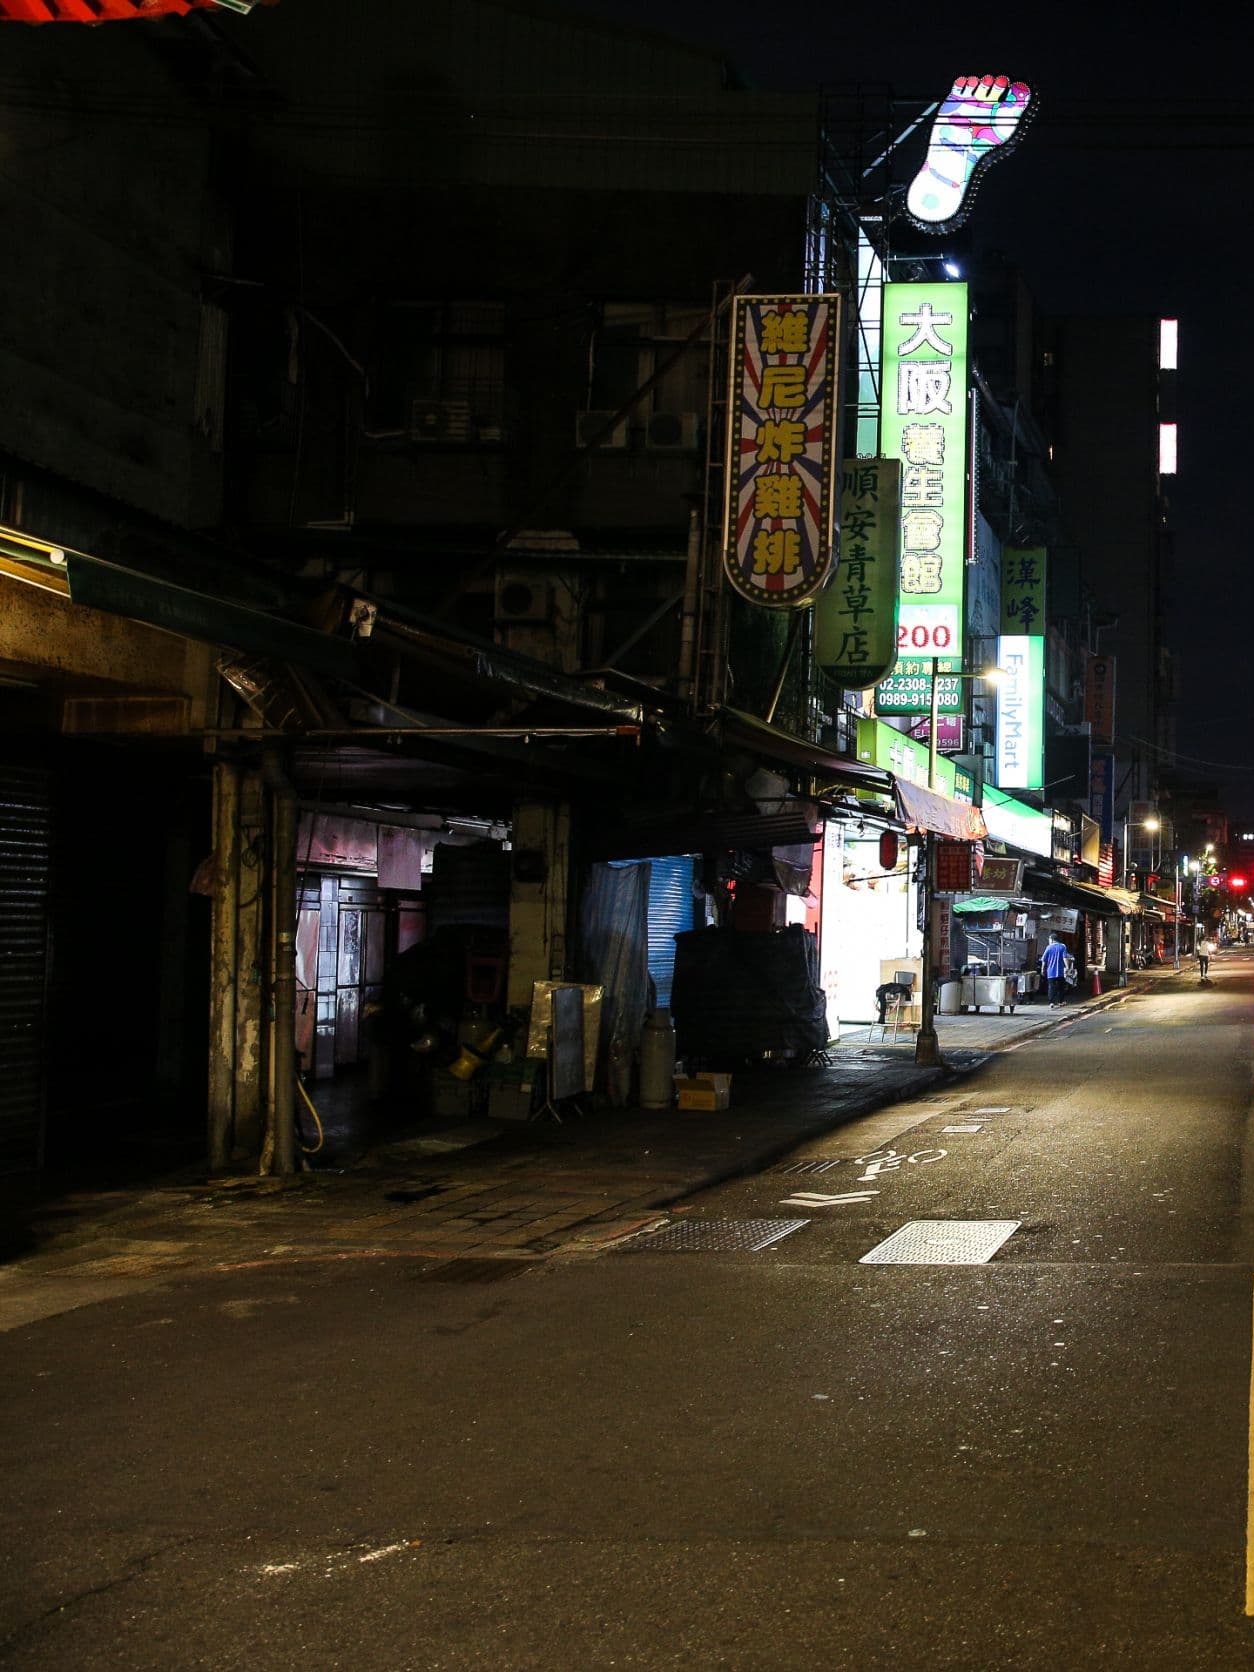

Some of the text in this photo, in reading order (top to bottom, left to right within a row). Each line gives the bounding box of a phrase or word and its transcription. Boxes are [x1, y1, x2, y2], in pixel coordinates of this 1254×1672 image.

[752, 310, 810, 576] 維尼炸雞排
[836, 465, 878, 664] 順安青草店
[880, 678, 959, 691] 02-2308-237
[880, 693, 959, 707] 0989-915080
[1002, 653, 1023, 769] FamilyMart
